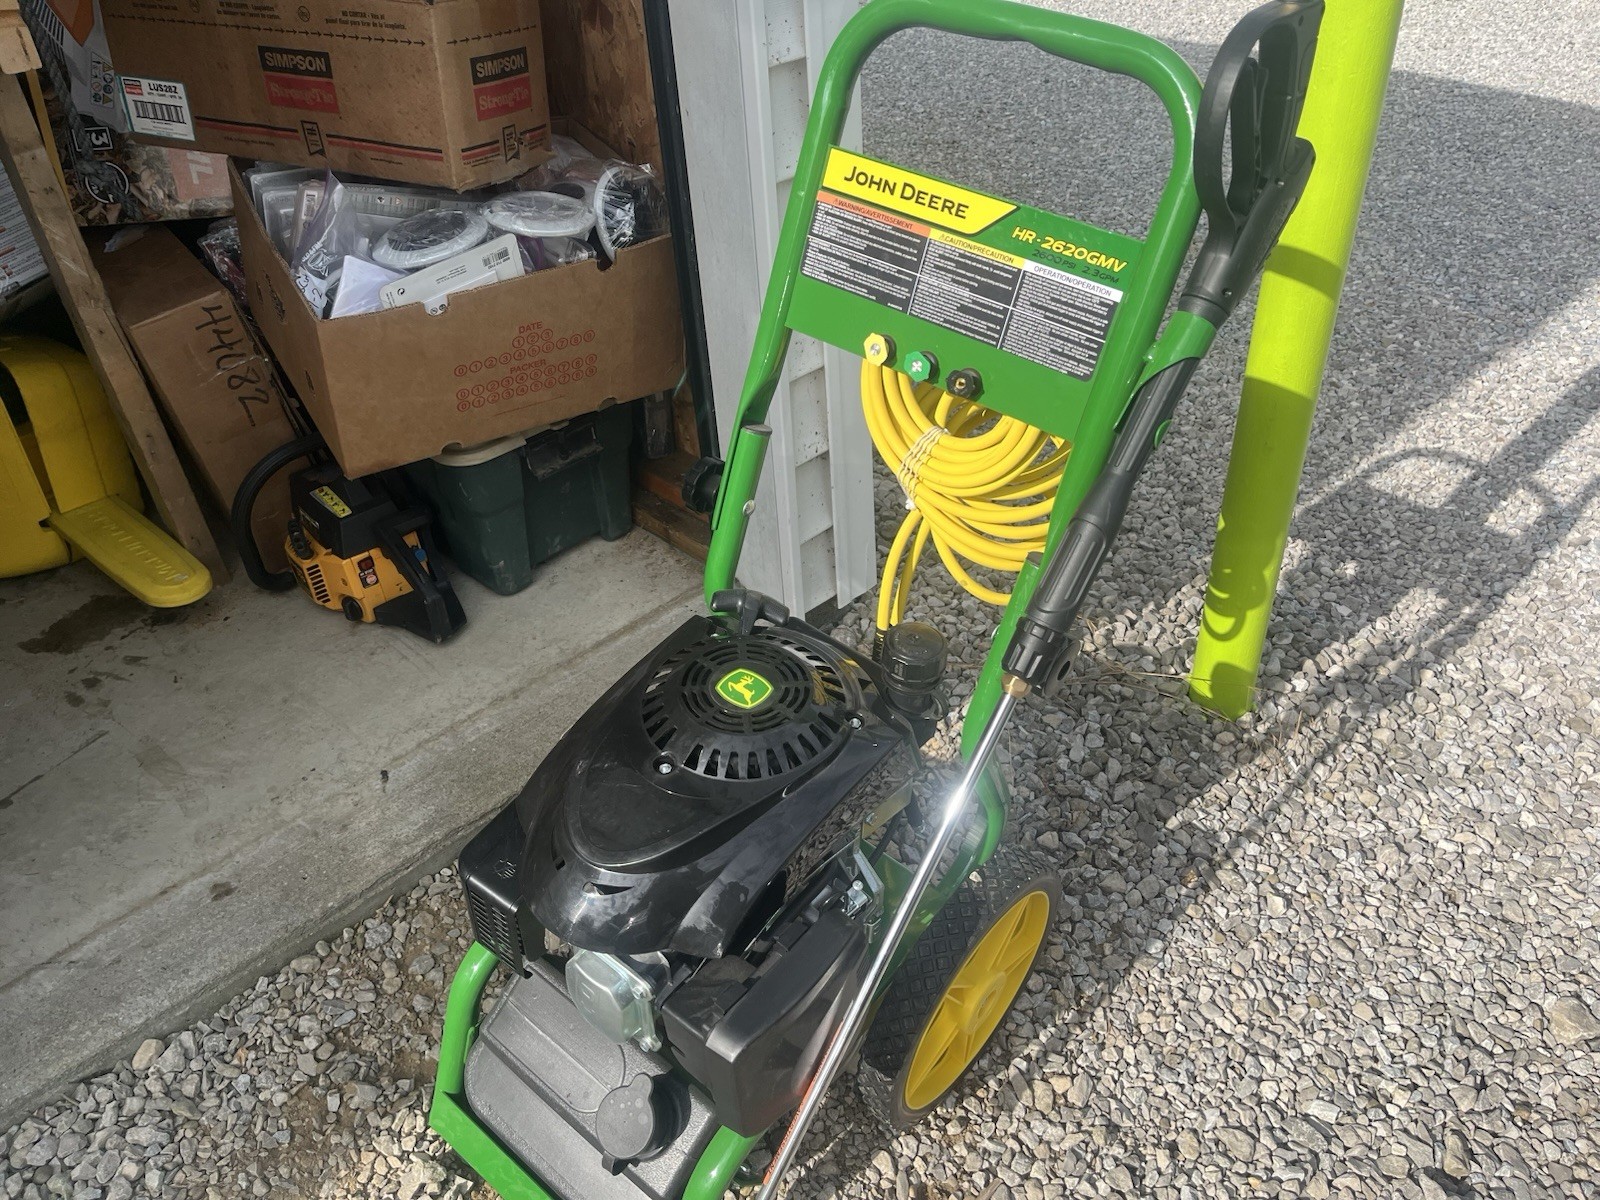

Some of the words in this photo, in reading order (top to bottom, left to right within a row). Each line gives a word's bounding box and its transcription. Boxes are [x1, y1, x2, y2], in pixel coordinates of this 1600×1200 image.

[264, 51, 327, 72] SIMPSON
[475, 53, 525, 78] SIMPSON
[843, 166, 897, 196] JOHN
[899, 182, 970, 219] DEERE
[838, 199, 914, 230] WARNING/AVERTISSEMENT
[944, 237, 1014, 264] CAUTION/PRÉCAUTION
[518, 321, 543, 334] DATE
[510, 359, 547, 374] PACKER
